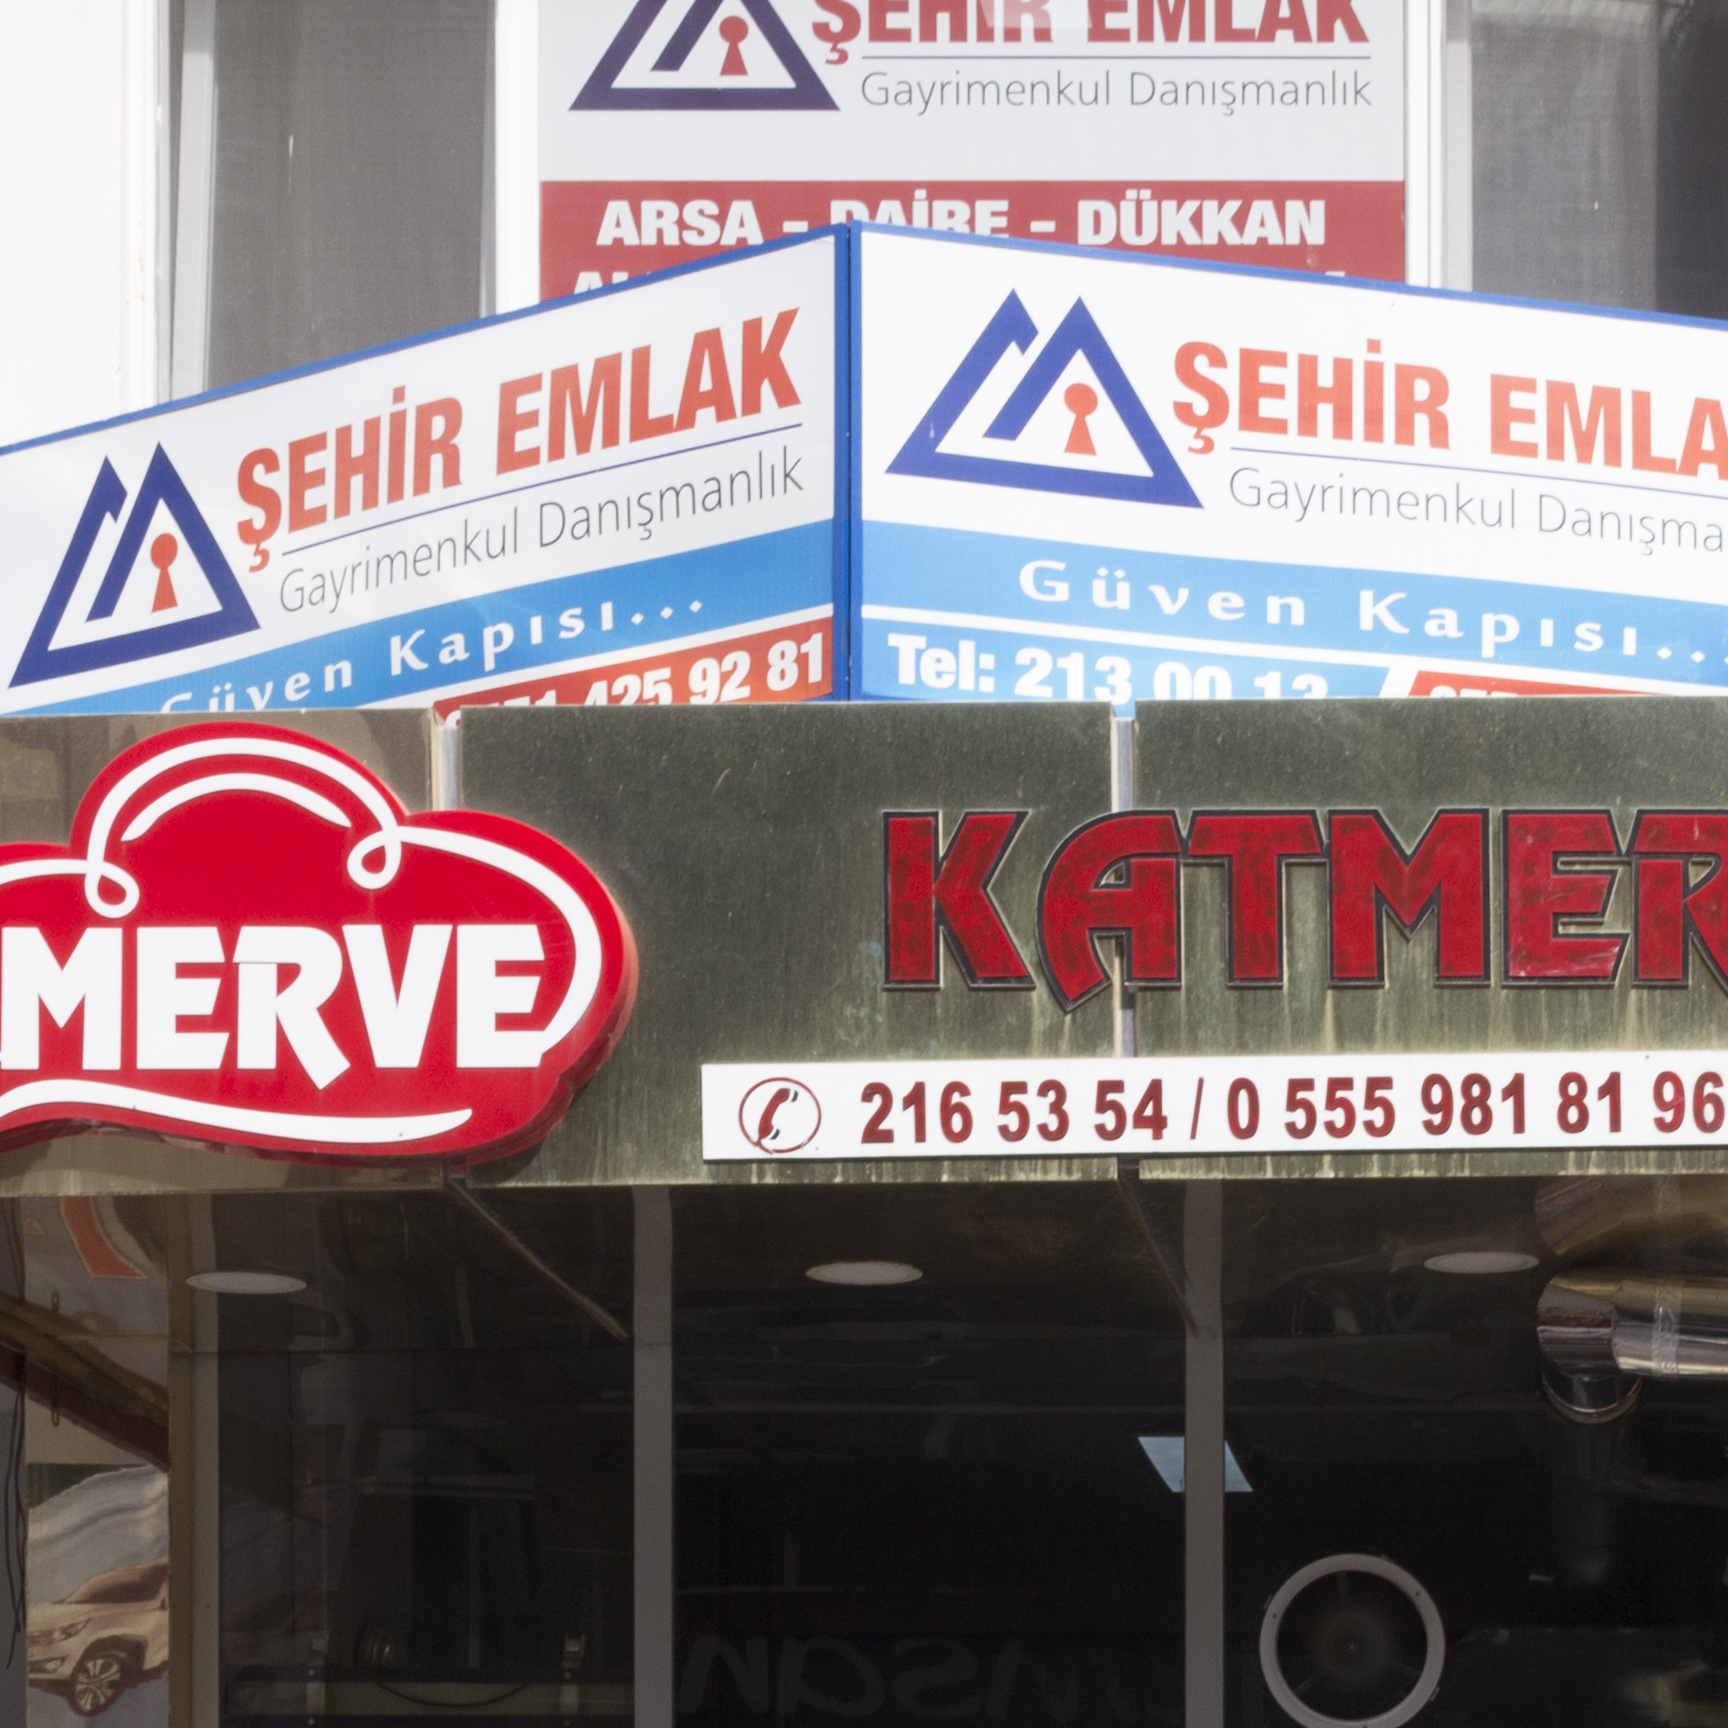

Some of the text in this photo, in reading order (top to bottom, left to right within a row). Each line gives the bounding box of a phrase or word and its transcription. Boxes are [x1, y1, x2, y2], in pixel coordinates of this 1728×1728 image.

[861, 70, 1373, 116] Gayrimenkul Danışmanlık
[597, 199, 763, 246] ARSA
[1077, 190, 1325, 246] DÜKKAN
[1172, 338, 1451, 454] ŞEHİR
[237, 307, 803, 571] ŞEHİR EMLAK
[280, 446, 805, 616] Gayrimenkul Danışmanlık
[1230, 467, 1517, 532] Gayrimenkul
[1019, 561, 1306, 627] Güven
[688, 651, 750, 705] 92
[767, 632, 823, 692] 81
[888, 634, 996, 695] Tel:
[1015, 647, 1132, 704] 213
[0, 923, 545, 1091] MERVE
[859, 1073, 973, 1145] 216
[995, 1077, 1071, 1143] 53
[1093, 1075, 1168, 1142] 54
[1226, 1075, 1261, 1141] 0
[1283, 1073, 1397, 1139] 555
[1420, 1071, 1528, 1137] 981
[1556, 1070, 1622, 1136] 81
[1650, 1070, 1726, 1136] 96
